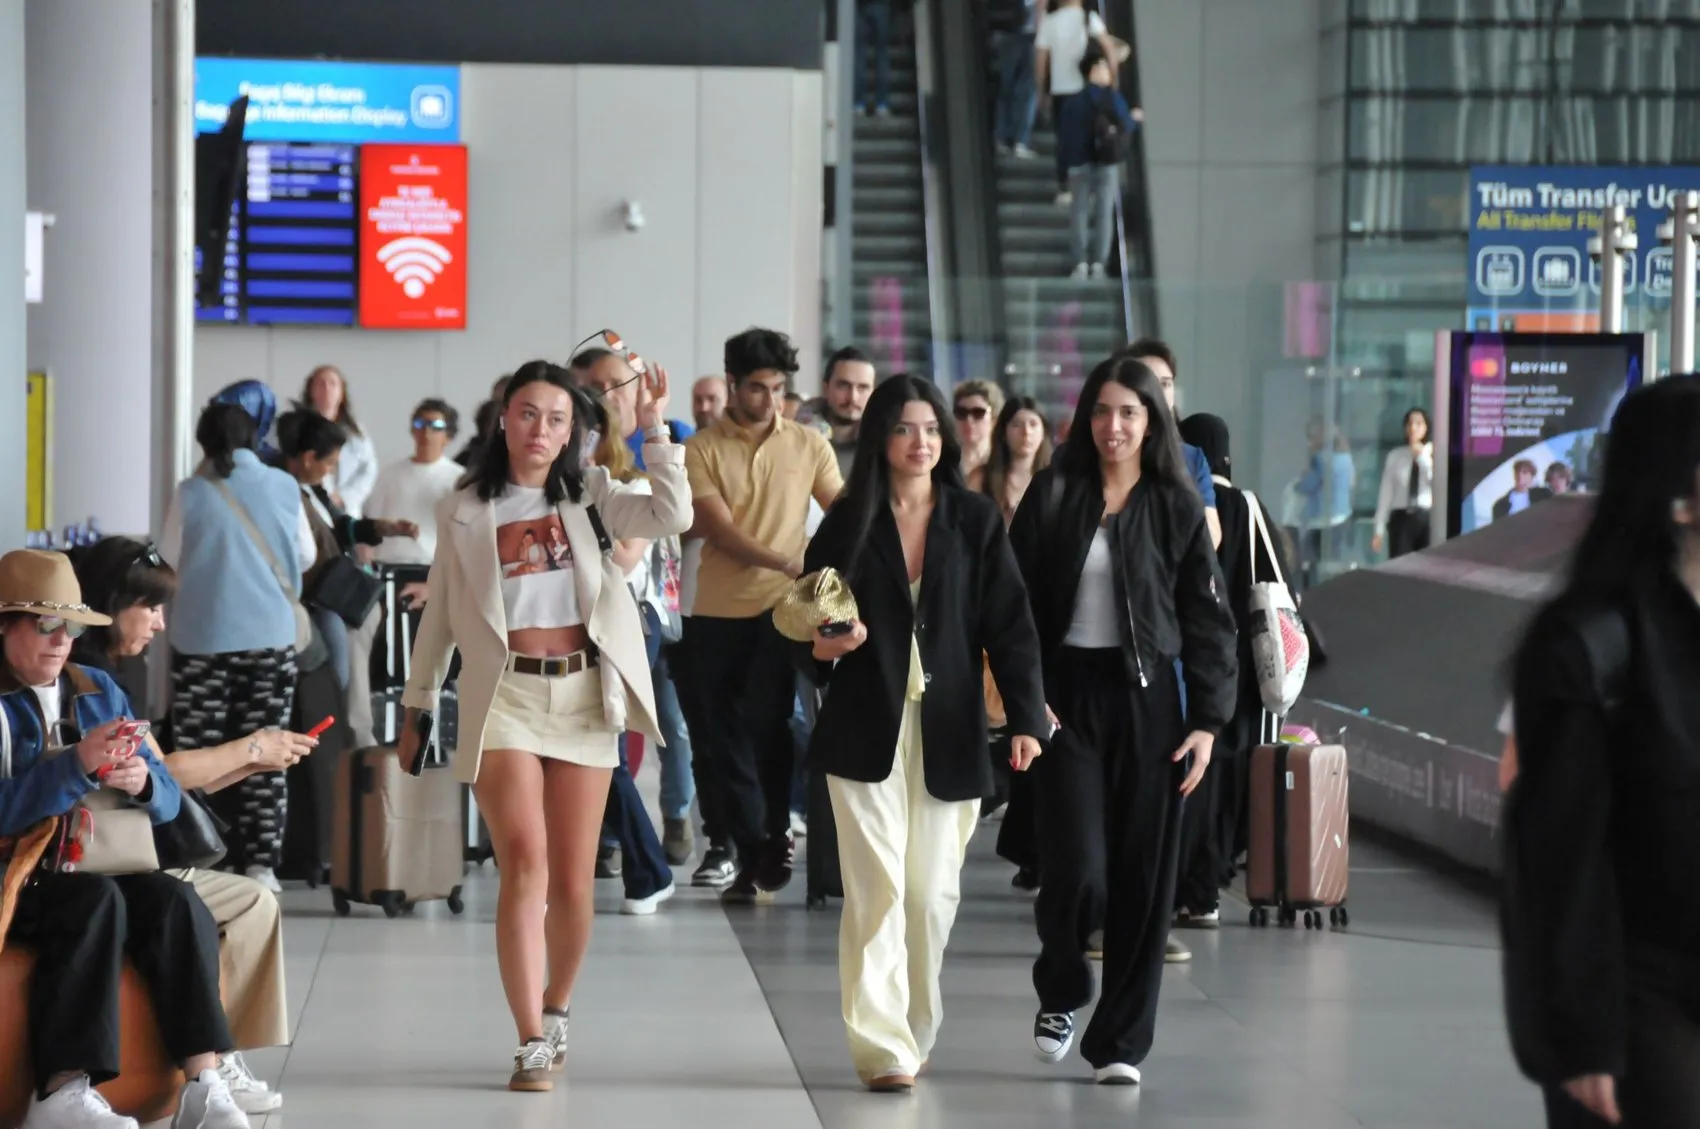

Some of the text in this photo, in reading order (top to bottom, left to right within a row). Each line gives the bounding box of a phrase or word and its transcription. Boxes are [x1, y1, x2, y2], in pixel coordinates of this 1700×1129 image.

[1477, 182, 1533, 208] Tüm
[1536, 182, 1642, 208] Transfer
[1504, 210, 1572, 231] Transfer
[1510, 361, 1568, 374] BOYNER
